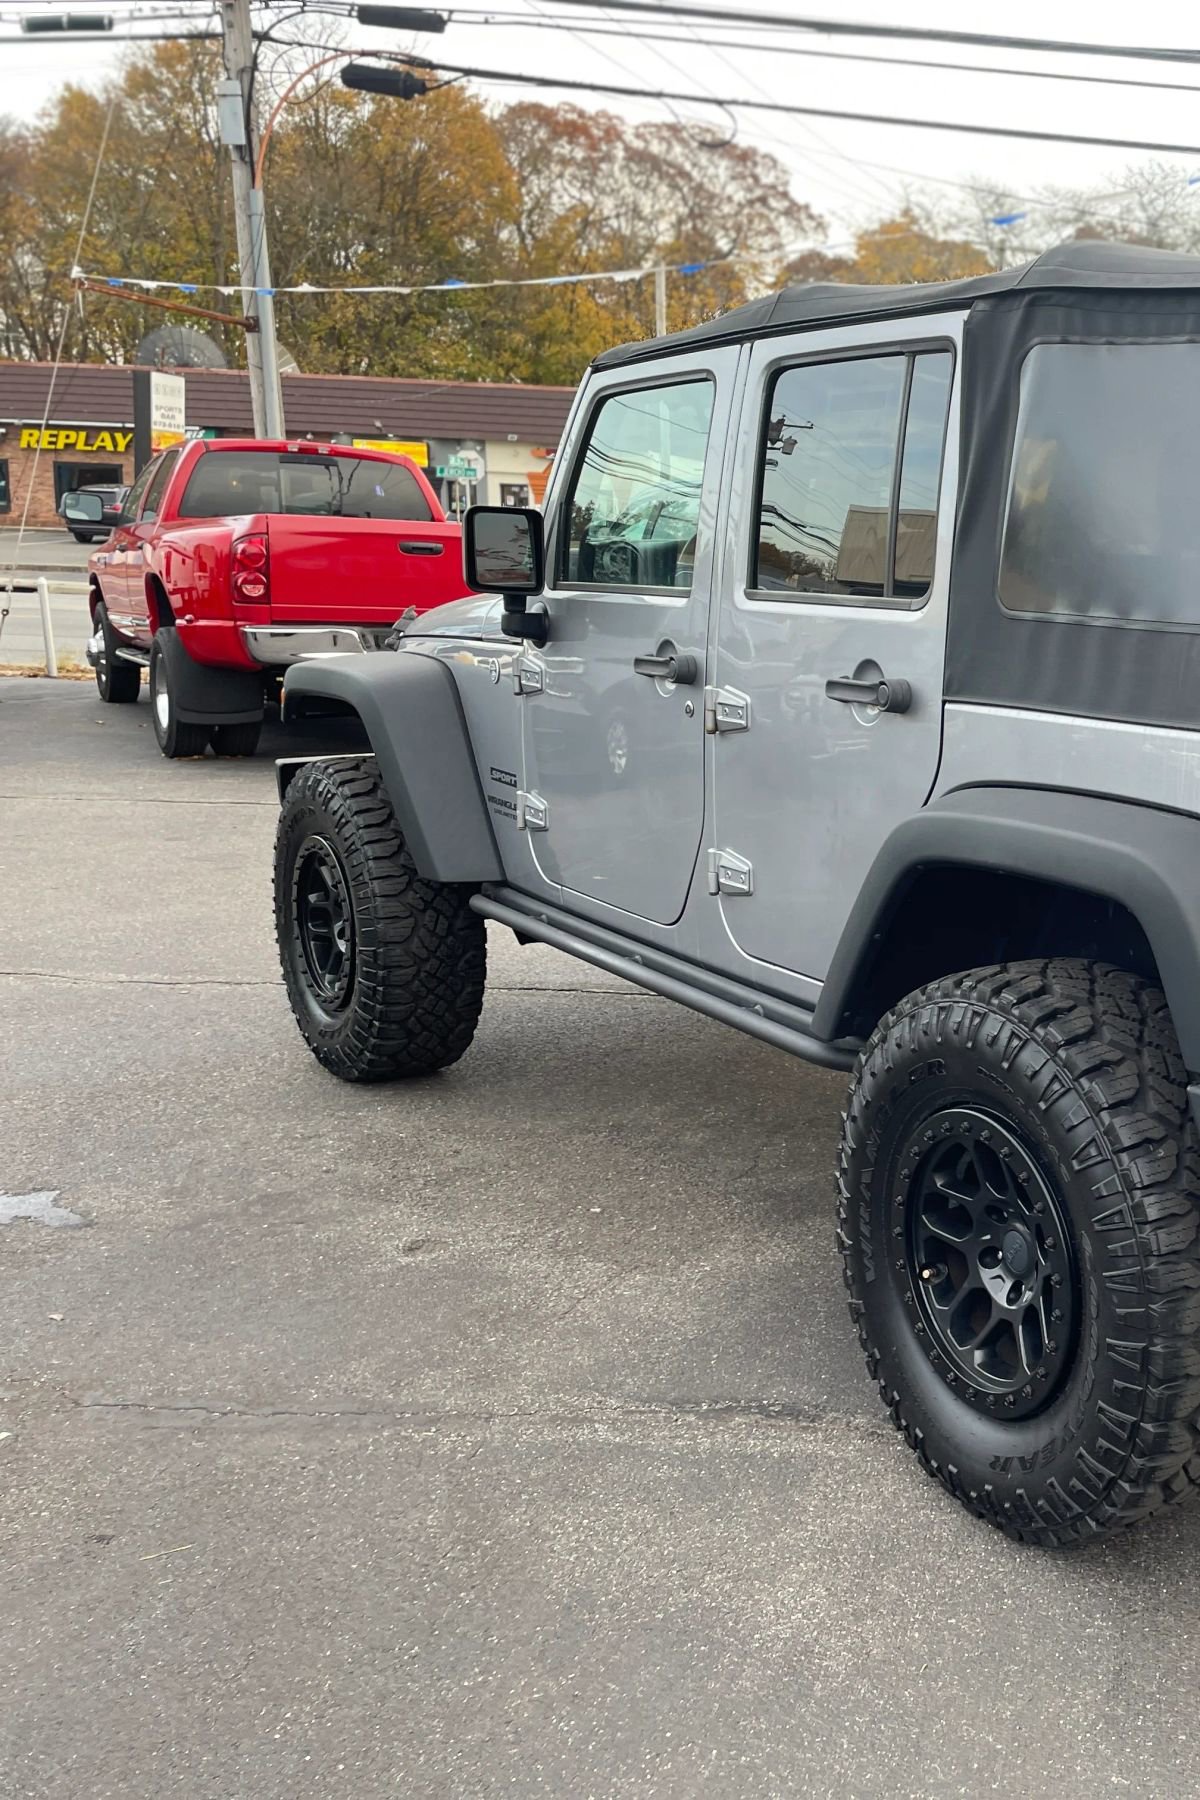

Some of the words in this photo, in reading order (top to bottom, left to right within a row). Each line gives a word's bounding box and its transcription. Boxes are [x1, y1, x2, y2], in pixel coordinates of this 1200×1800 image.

[20, 428, 134, 452] REPLAY
[491, 770, 517, 786] SPORT
[487, 795, 517, 811] WRANGLE
